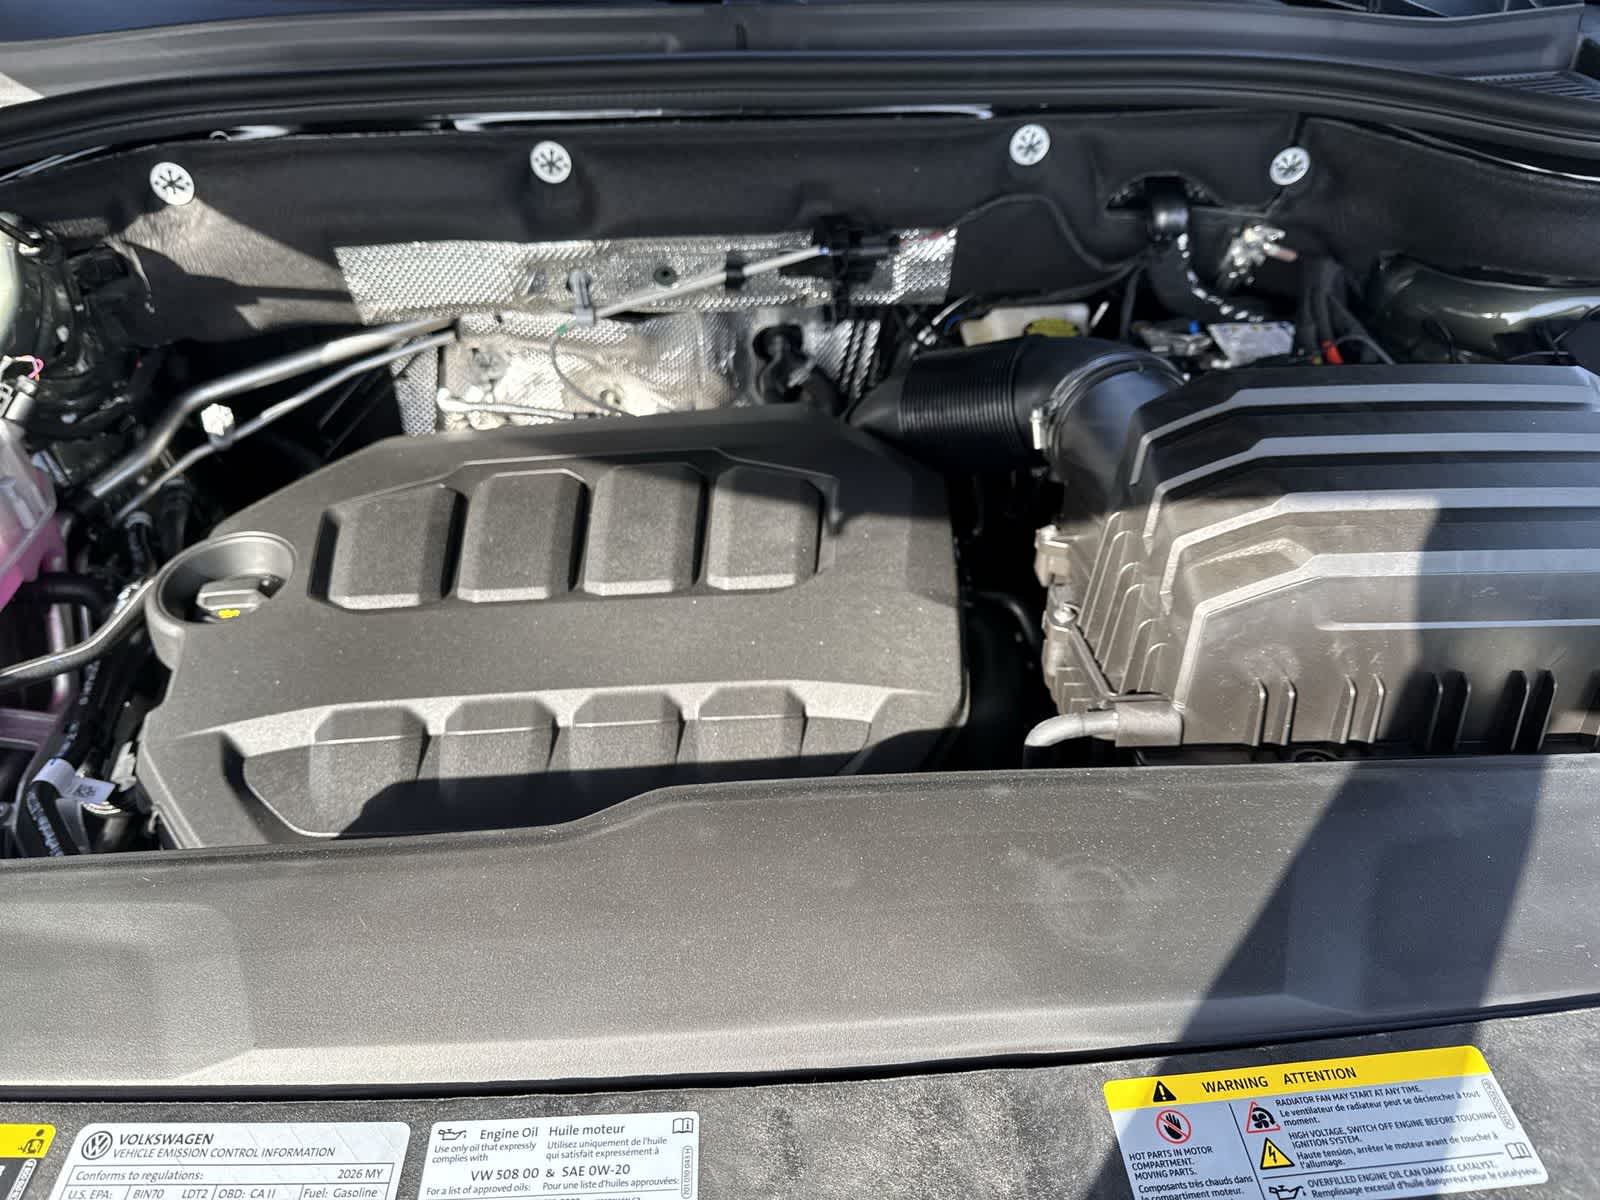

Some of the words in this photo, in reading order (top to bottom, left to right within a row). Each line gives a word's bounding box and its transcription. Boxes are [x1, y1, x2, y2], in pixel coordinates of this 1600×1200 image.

[1202, 1075, 1269, 1094] WARNING
[1284, 1067, 1357, 1085] ATTENTION
[1275, 1095, 1315, 1107] RADIATOR
[1315, 1093, 1332, 1103] FAN
[1332, 1091, 1350, 1101] MAY
[1350, 1089, 1374, 1100] START
[1374, 1088, 1385, 1097] AT
[1385, 1086, 1402, 1096] ANY
[1401, 1084, 1424, 1094] TIME.
[1280, 1109, 1290, 1118] Le
[1291, 1105, 1334, 1117] ventilateur
[1335, 1104, 1346, 1112] de
[1346, 1100, 1382, 1111] radiateur
[1383, 1098, 1402, 1109] peut
[1402, 1097, 1413, 1105] se
[1455, 1090, 1462, 1099] à
[1462, 1089, 1481, 1099] tout
[1283, 1116, 1321, 1127] moment.
[1288, 1130, 1310, 1141] HIGH
[1346, 1124, 1377, 1135] SWITCH
[1378, 1121, 1394, 1132] OFF
[1394, 1118, 1425, 1129] ENGINE
[1424, 1115, 1456, 1127] BEFORE
[1455, 1111, 1498, 1122] TOUCHING
[479, 1128, 520, 1143] Engine
[521, 1126, 539, 1138] Oil
[549, 1124, 580, 1137] Huile
[582, 1124, 626, 1136] moteur
[119, 1132, 215, 1146] VOLKSWAGEN
[547, 1139, 578, 1150] Utilisez
[579, 1138, 629, 1150] uniquement
[630, 1137, 642, 1146] de
[642, 1136, 668, 1146] l'huile
[1291, 1138, 1330, 1150] IGNITION
[1329, 1135, 1362, 1146] SYSTEM.
[1296, 1150, 1322, 1161] Haute
[1322, 1147, 1357, 1158] tension,
[1356, 1144, 1385, 1154] arrêter
[1384, 1142, 1395, 1151] le
[1394, 1139, 1425, 1150] moteur
[1425, 1137, 1449, 1147] avant
[1449, 1135, 1459, 1144] de
[1459, 1131, 1491, 1143] toucher
[113, 1148, 155, 1159] VEHICLE
[157, 1147, 209, 1159] EMISSION
[210, 1147, 259, 1158] CONTROL
[260, 1147, 336, 1158] INFORMATION
[434, 1144, 450, 1154] Use
[450, 1143, 469, 1155] only
[469, 1143, 480, 1152] oil
[481, 1142, 498, 1152] that
[499, 1141, 537, 1152] expressly
[546, 1150, 560, 1162] qui
[560, 1149, 594, 1160] satisfait
[595, 1147, 652, 1159] expressément
[654, 1146, 660, 1156] à
[1128, 1151, 1146, 1162] HOT
[1147, 1149, 1173, 1160] PARTS
[1173, 1147, 1183, 1157] IN
[1183, 1145, 1214, 1157] MOTOR
[431, 1153, 469, 1166] complies
[469, 1152, 489, 1162] with
[1131, 1157, 1196, 1171] COMPARTMENT.
[75, 1170, 126, 1181] Conforms
[128, 1171, 140, 1181] to
[141, 1169, 204, 1183] regulations:
[337, 1168, 363, 1180] 2026
[365, 1168, 384, 1179] MY
[470, 1169, 494, 1182] VW
[495, 1168, 520, 1181] 508
[522, 1167, 540, 1179] 00
[545, 1168, 556, 1179] &
[561, 1164, 586, 1178] SAE
[588, 1163, 631, 1177] 0W-20
[1134, 1169, 1169, 1181] MOVING
[1168, 1167, 1198, 1178] PARTS.
[1307, 1175, 1357, 1188] OVERFILLED
[1357, 1173, 1390, 1184] ENGINE
[1389, 1169, 1404, 1180] OIL
[1403, 1167, 1421, 1178] CAN
[1421, 1163, 1457, 1176] DAMAGE
[426, 1185, 441, 1196] For
[440, 1187, 448, 1196] a
[448, 1185, 462, 1196] list
[462, 1184, 473, 1195] of
[472, 1182, 514, 1196] approved
[513, 1181, 532, 1193] oils:
[542, 1181, 562, 1192] Pour
[562, 1181, 579, 1191] une
[580, 1179, 598, 1190] liste
[597, 1178, 630, 1189] d'huiles
[1138, 1180, 1188, 1194] Composants
[1187, 1178, 1205, 1189] très
[1204, 1175, 1234, 1187] chauds
[1233, 1175, 1254, 1184] dans
[1311, 1186, 1364, 1199] Remplissage
[1364, 1181, 1396, 1194] excessif
[67, 1189, 87, 1200] U.S.
[88, 1189, 113, 1200] EPA:
[132, 1188, 165, 1200] BIN70
[181, 1188, 209, 1200] LDT2
[217, 1188, 246, 1200] OBD:
[249, 1188, 265, 1199] CA
[302, 1187, 329, 1199] Fuel:
[332, 1186, 379, 1198] Gasoline
[1211, 1187, 1245, 1198] moteur.
